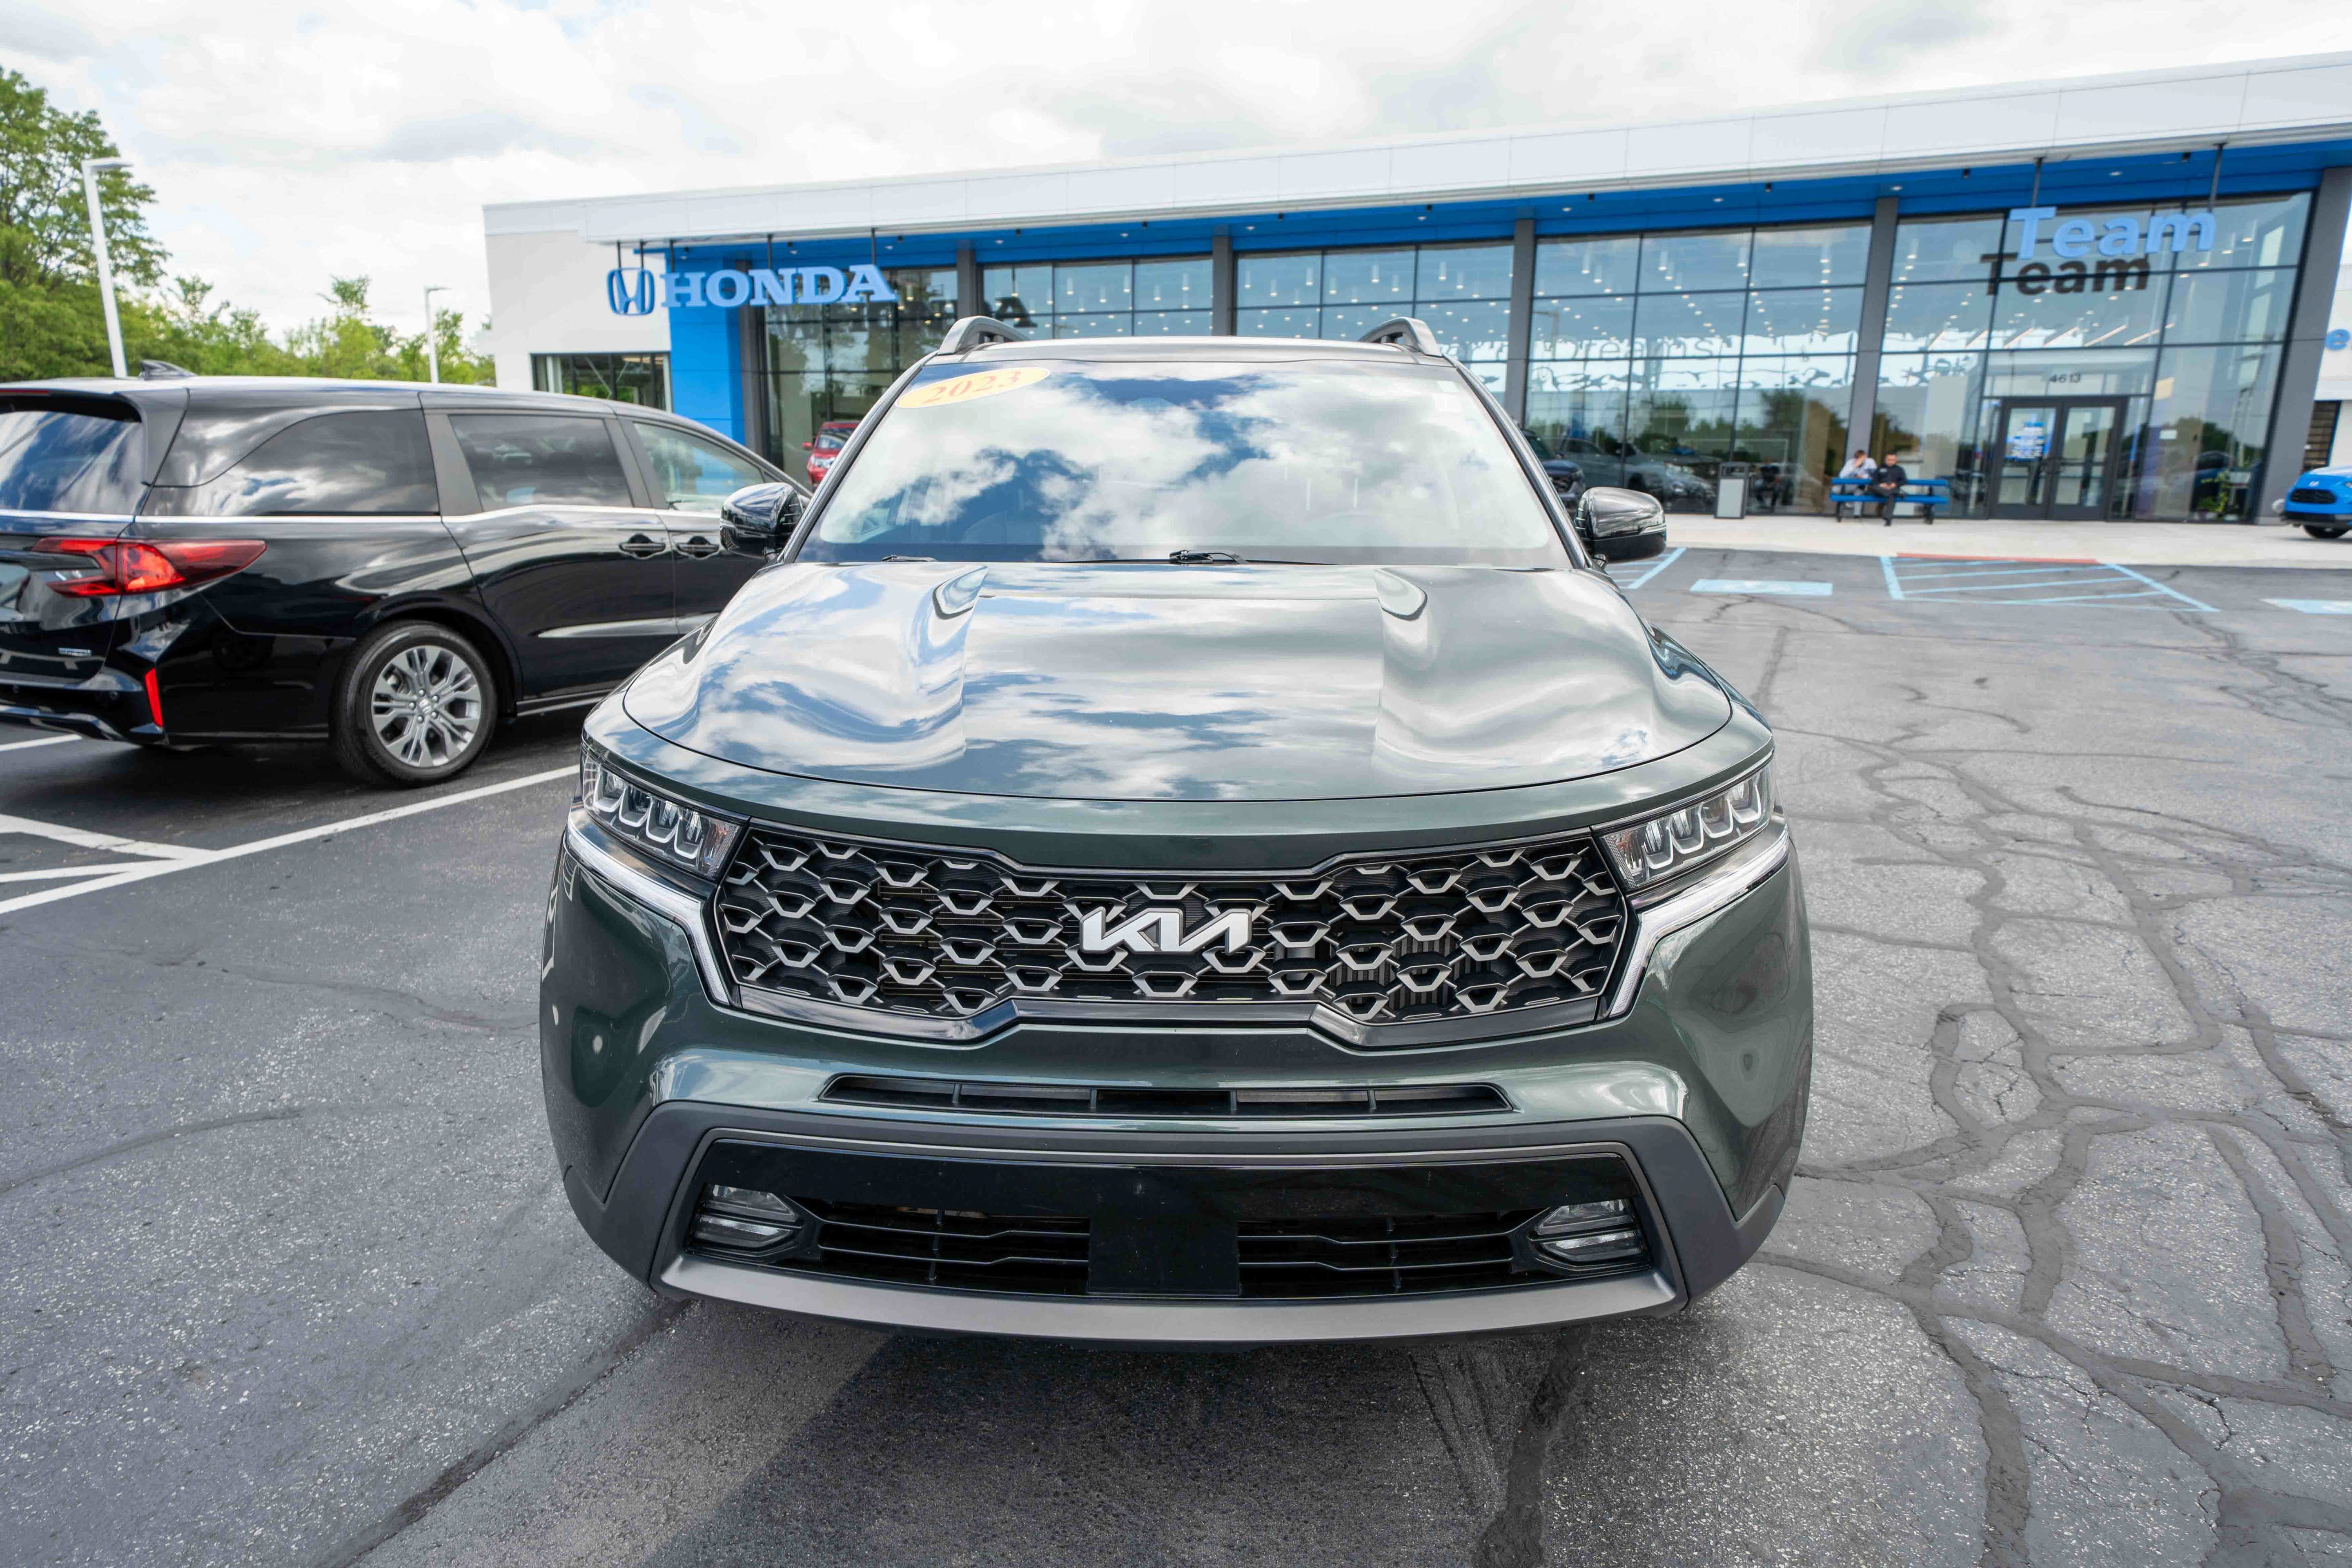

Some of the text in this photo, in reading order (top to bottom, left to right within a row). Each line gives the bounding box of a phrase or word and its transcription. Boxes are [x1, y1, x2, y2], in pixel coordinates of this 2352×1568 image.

[2009, 207, 2216, 259] Team
[662, 264, 898, 307] HONDA
[1980, 252, 2150, 296] Team
[922, 371, 1021, 403] 2023
[2049, 372, 2081, 383] 4613
[1079, 906, 1252, 956] KIA
